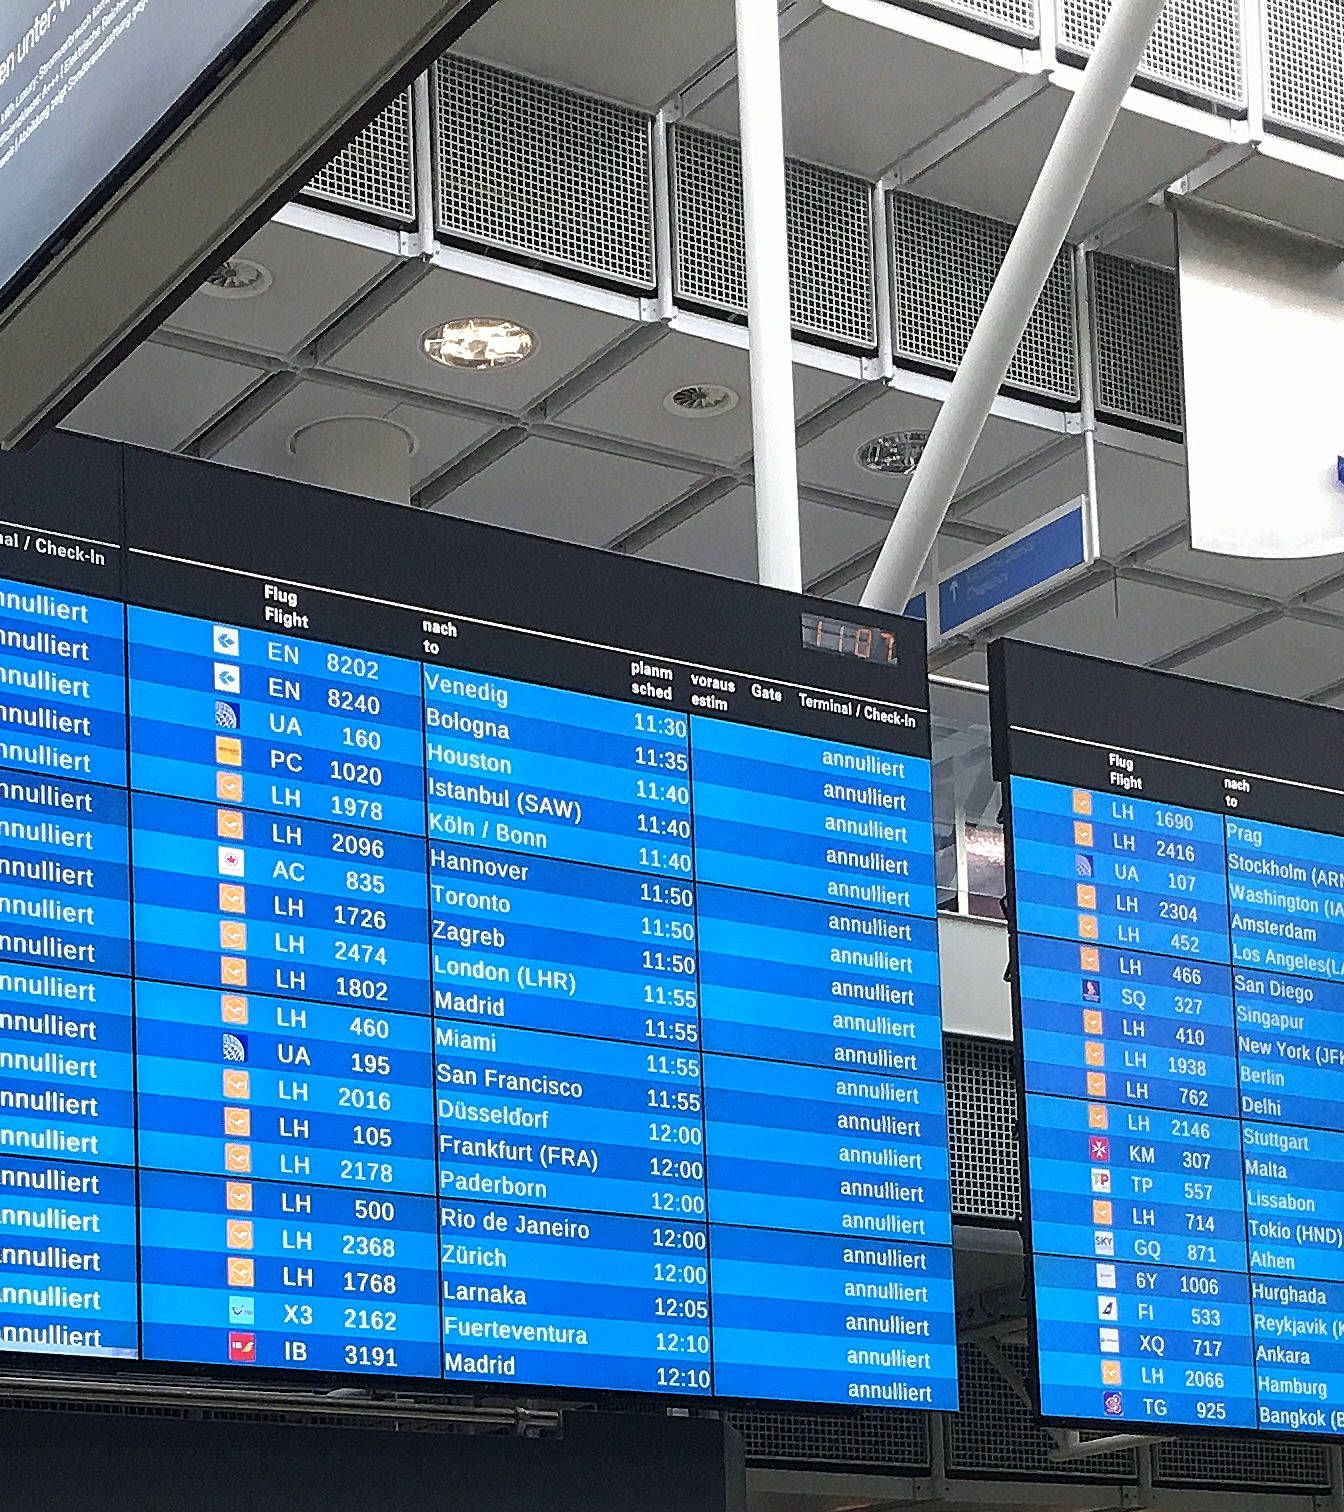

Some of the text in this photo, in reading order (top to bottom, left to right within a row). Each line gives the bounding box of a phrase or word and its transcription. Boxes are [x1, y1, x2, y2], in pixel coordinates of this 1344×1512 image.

[36, 538, 104, 565] Check-In
[265, 584, 297, 607] Flug
[265, 606, 308, 628] Flight
[423, 621, 457, 637] nach
[423, 640, 439, 654] to
[631, 661, 672, 680] planm
[691, 674, 735, 692] voraus
[752, 684, 782, 702] Gate
[799, 693, 852, 715] Terminal
[864, 706, 915, 728] Check-In
[632, 682, 727, 710] sched estim
[269, 642, 905, 779] EN 8202 Venedig 11:30 annulliert
[1109, 753, 1133, 772] Flug
[1111, 772, 1142, 789] Flight
[1224, 779, 1250, 792] nach
[1225, 795, 1237, 807] to
[1114, 833, 1135, 851] LH
[1157, 841, 1194, 861] 2416
[1229, 853, 1306, 881] Stockholm
[278, 1044, 920, 1136] UA 195 San Francisco 11:55 annulliert
[1130, 1146, 1154, 1163] KM
[1183, 1152, 1210, 1169] 307
[1245, 1159, 1288, 1178] Malta
[282, 1193, 926, 1269] LH 500 Rio de Janeiro 12:00 annulliert
[1095, 1236, 1112, 1247] SKY
[1144, 1398, 1167, 1416] TG
[1197, 1402, 1226, 1421] 925
[1260, 1407, 1325, 1430] Bangkok
